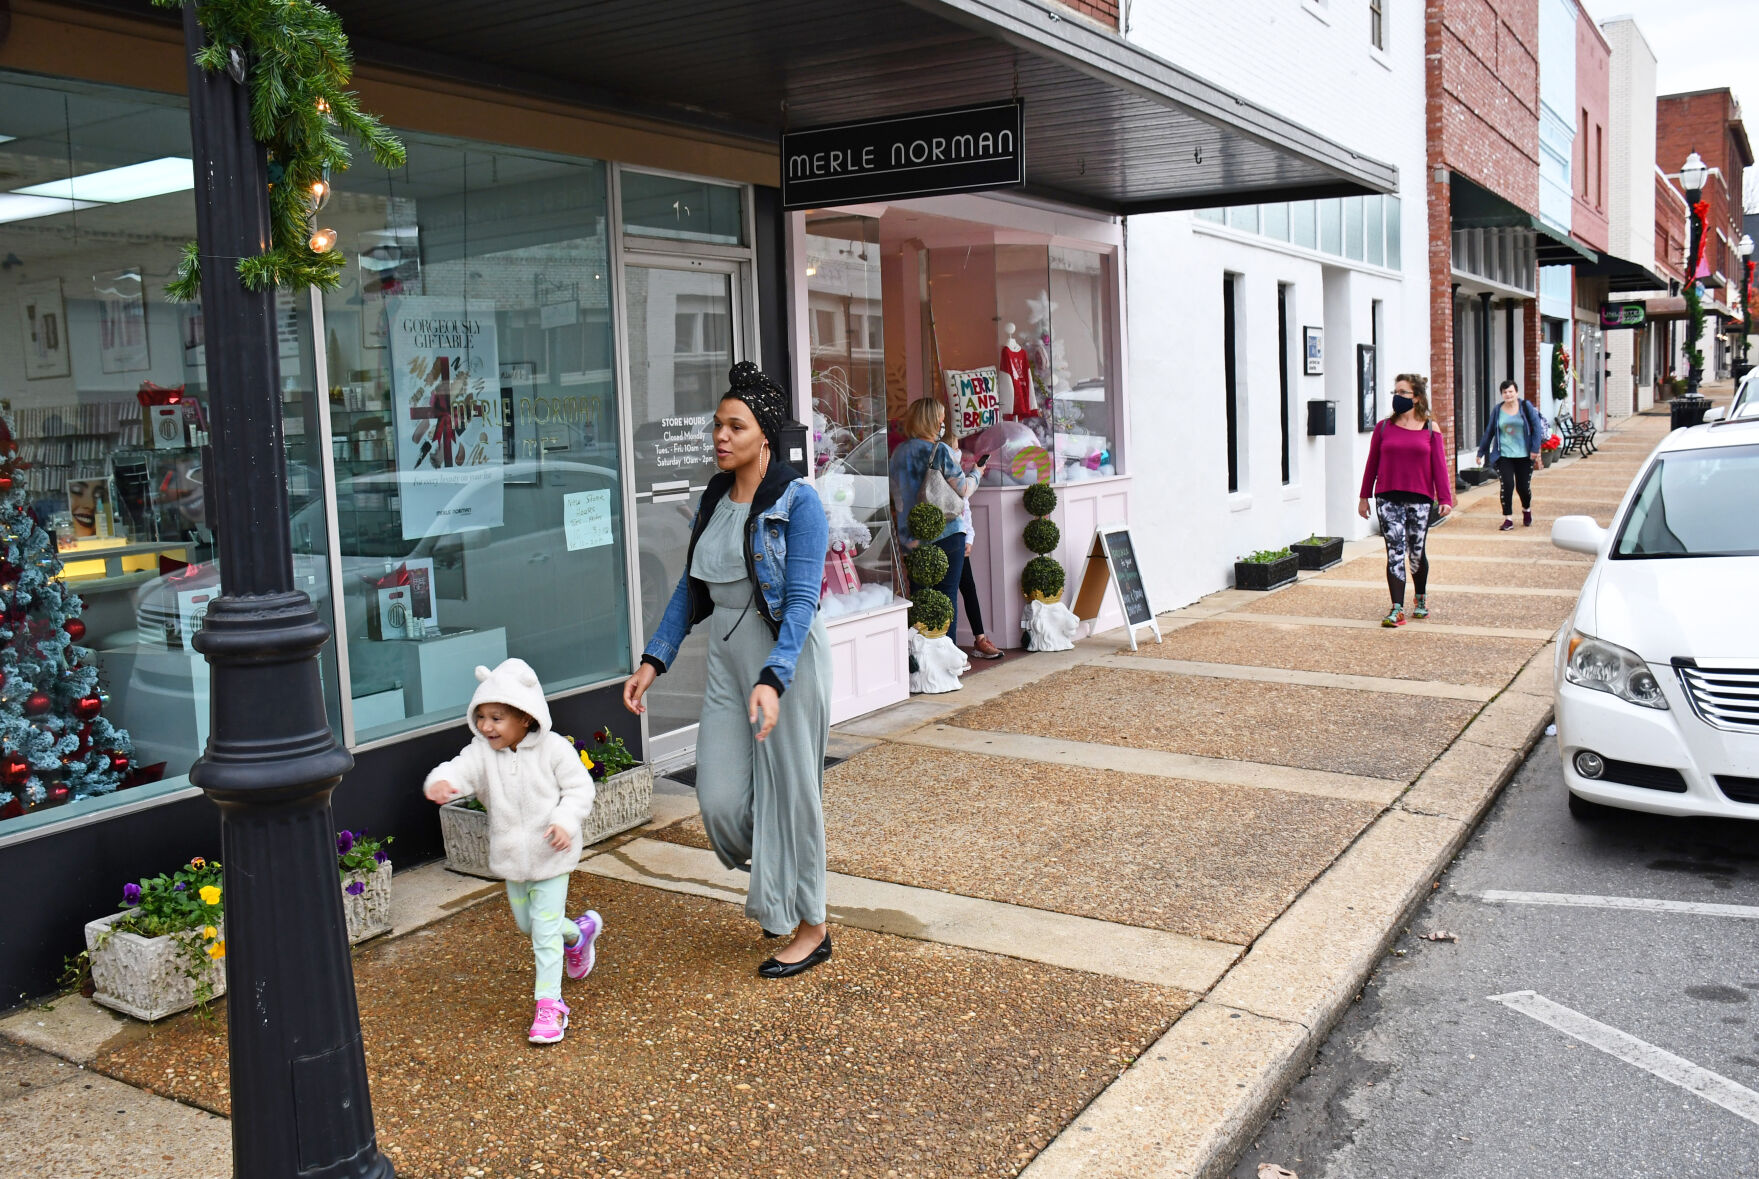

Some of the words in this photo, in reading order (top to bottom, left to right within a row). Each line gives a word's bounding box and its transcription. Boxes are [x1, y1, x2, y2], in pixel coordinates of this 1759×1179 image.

[789, 146, 875, 178] MERLE
[891, 129, 1013, 166] NORMAN
[403, 319, 480, 335] GORGEOUSLY
[414, 334, 474, 349] GIFTABLE
[960, 376, 996, 397] MERRY
[520, 395, 603, 426] NORMAN
[965, 395, 997, 411] AND
[661, 417, 683, 427] STORE
[683, 416, 706, 426] HOURS
[963, 408, 999, 428] BRIGHT
[663, 430, 683, 441] Closed
[683, 429, 706, 441] Monday
[654, 444, 670, 455] Tues.
[673, 442, 684, 453] Fri.
[684, 444, 699, 453] 10am
[656, 455, 681, 468] Saturday
[683, 456, 699, 465] 10am
[702, 454, 714, 466] 2pm
